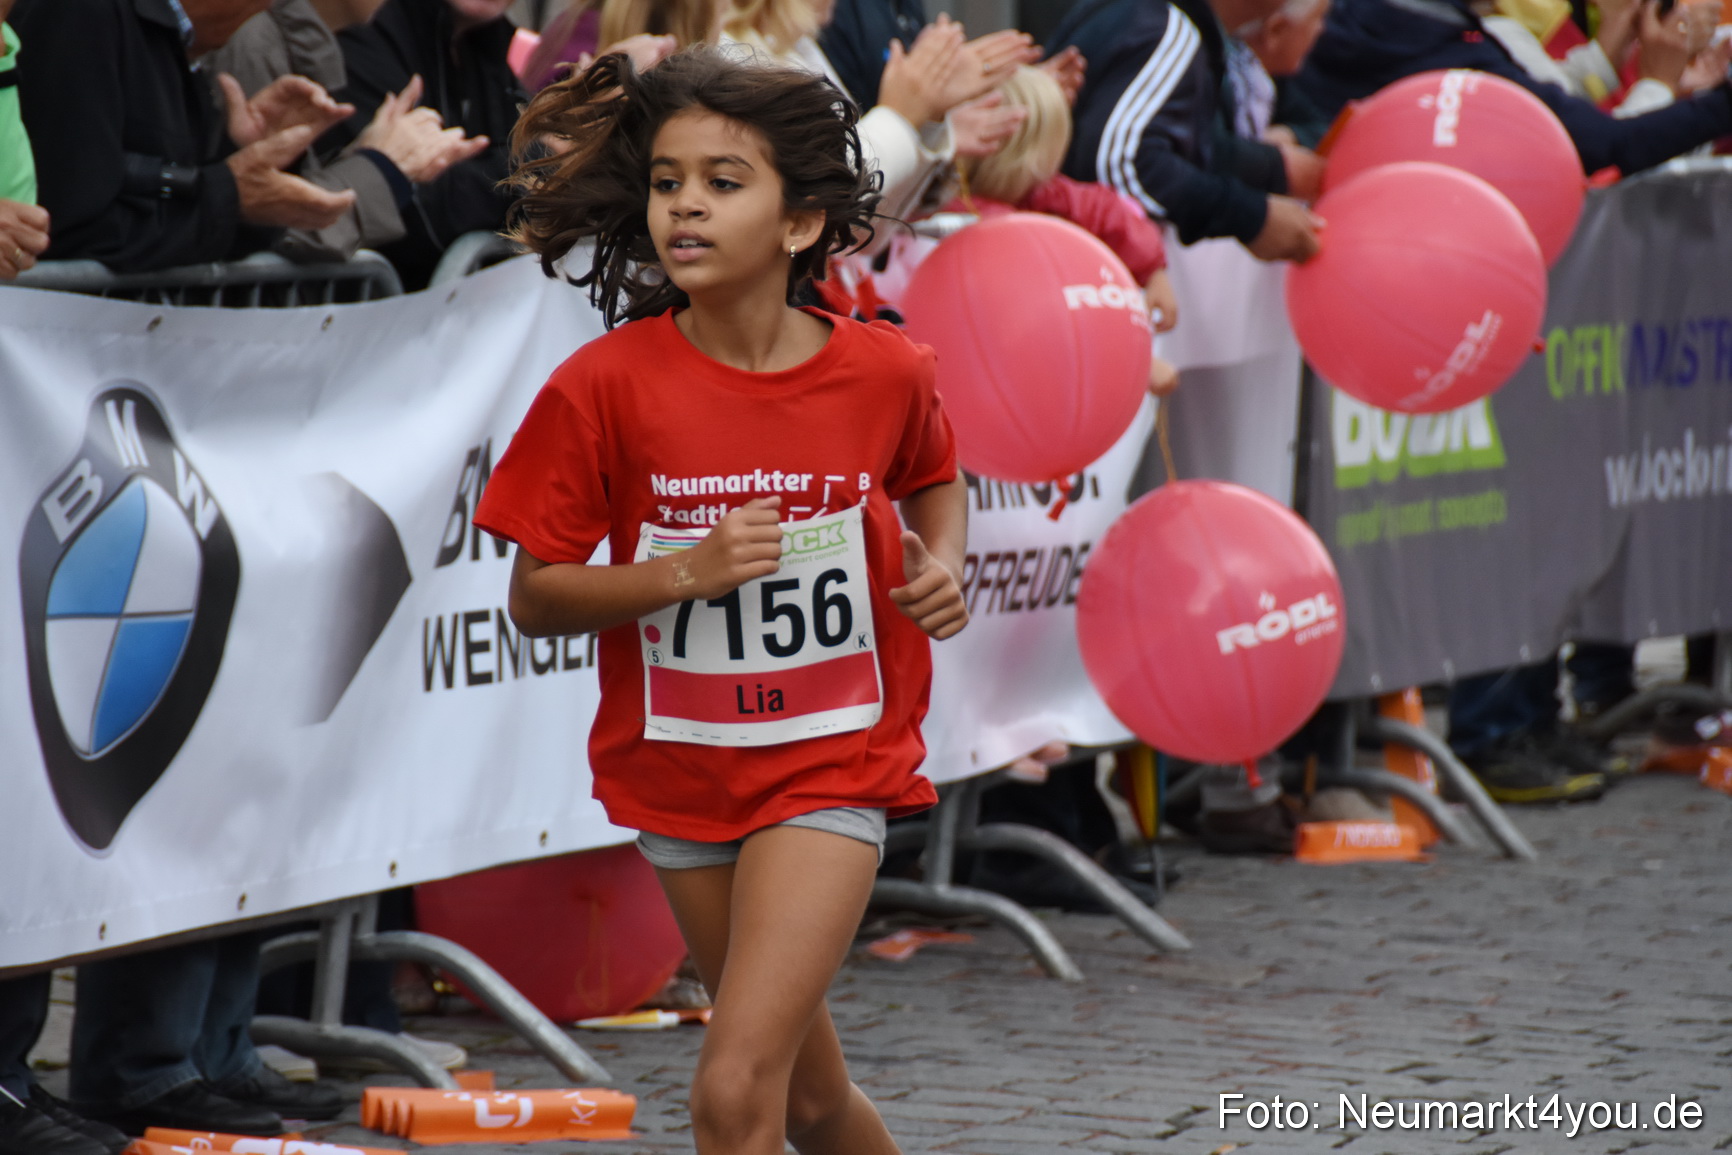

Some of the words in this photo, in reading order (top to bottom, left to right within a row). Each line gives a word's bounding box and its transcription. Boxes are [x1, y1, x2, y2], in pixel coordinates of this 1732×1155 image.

[41, 398, 219, 545] BMW
[651, 468, 813, 496] Neumarkter
[962, 541, 1091, 616] RFREUDE
[673, 568, 853, 661] 7156
[651, 650, 660, 664] 5
[858, 635, 867, 648] K
[736, 684, 785, 715] Lia
